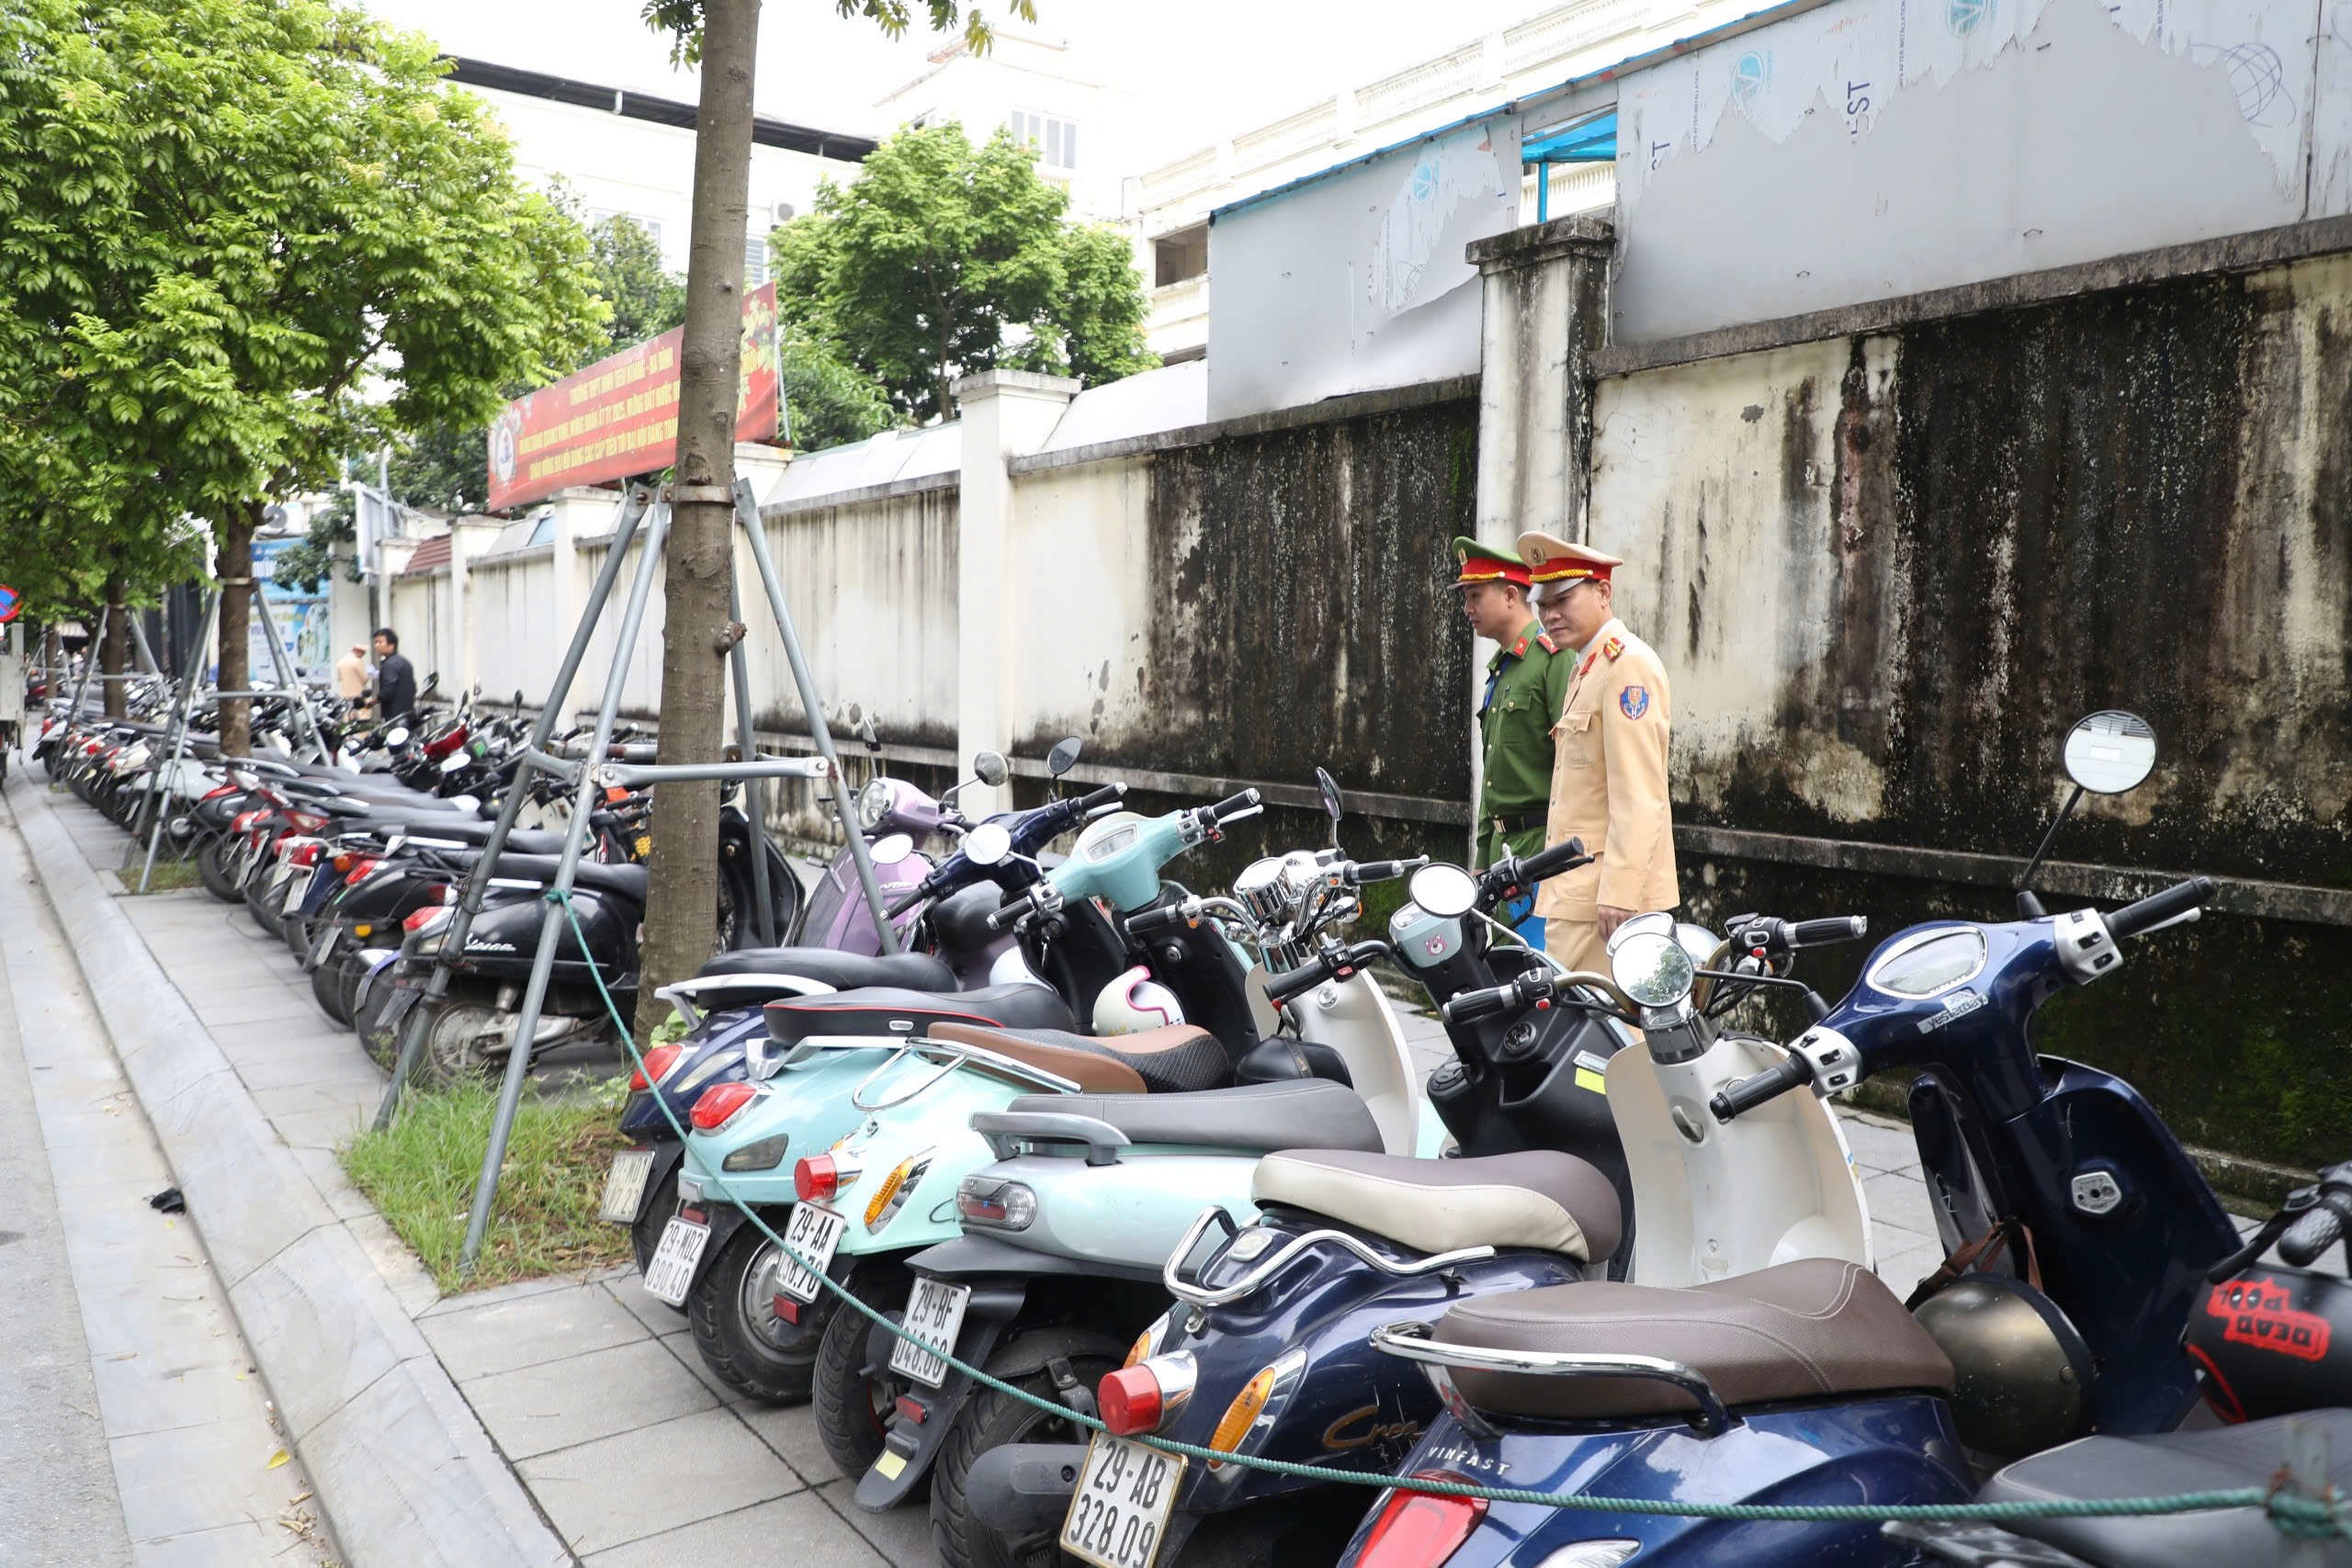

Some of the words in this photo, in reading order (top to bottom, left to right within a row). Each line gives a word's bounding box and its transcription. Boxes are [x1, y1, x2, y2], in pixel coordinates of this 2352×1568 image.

[790, 1206, 835, 1254] 29-AA
[910, 1281, 959, 1331] 29-BF
[2236, 1314, 2312, 1348] DEAD
[1092, 1439, 1168, 1510] 29-AB
[1428, 1446, 1511, 1476] VINFAST
[1070, 1493, 1157, 1568] 328.09
